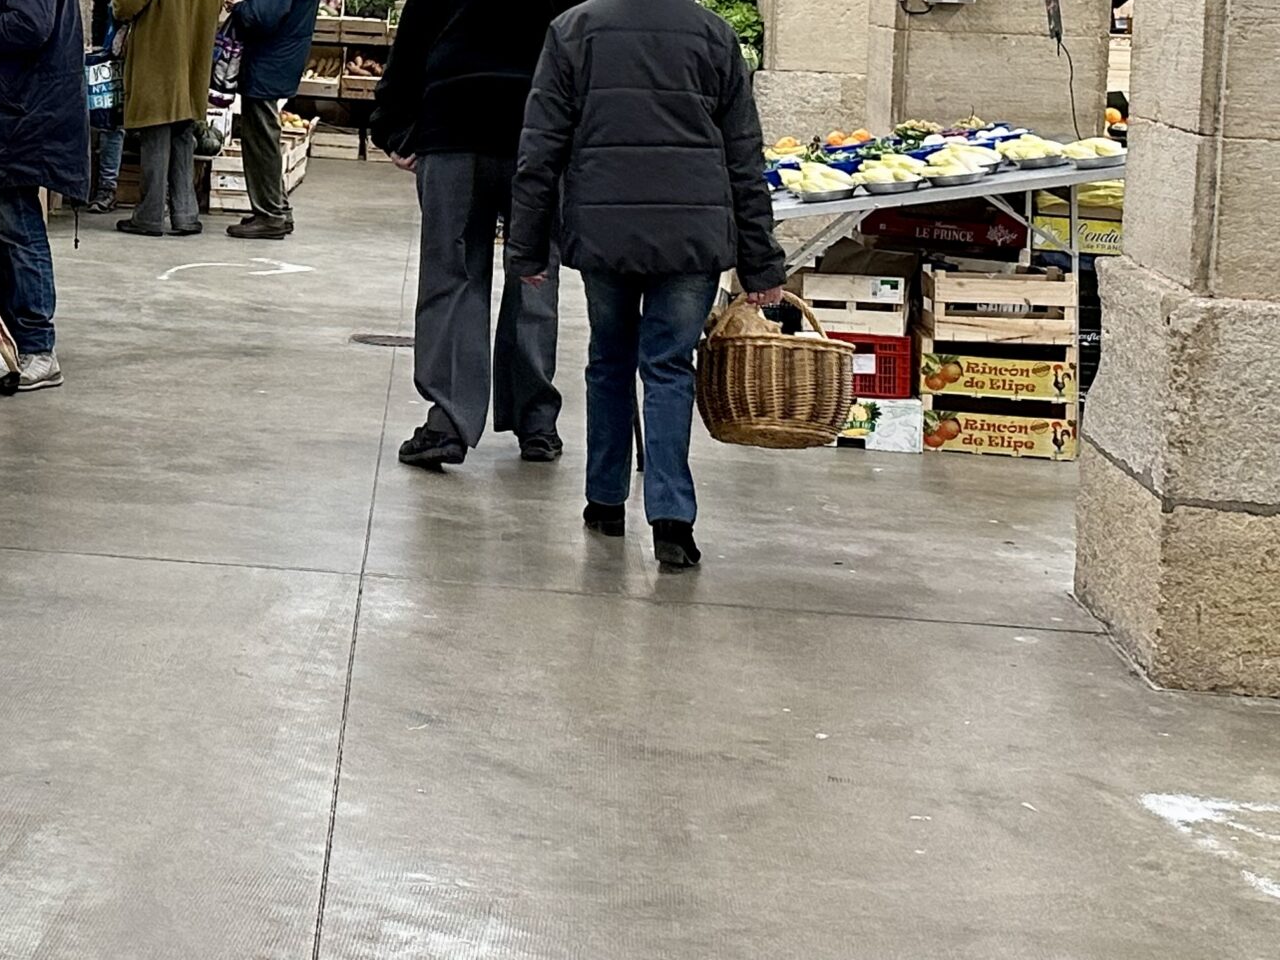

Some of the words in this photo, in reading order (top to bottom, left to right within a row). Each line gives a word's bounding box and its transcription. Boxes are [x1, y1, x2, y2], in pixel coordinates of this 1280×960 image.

[915, 227, 930, 239] LE
[933, 228, 974, 242] PRINCE
[964, 361, 1030, 378] Rincón
[963, 377, 986, 390] de
[988, 377, 1037, 395] Elipe
[963, 418, 1029, 435] Rincón
[961, 433, 984, 446] de
[987, 435, 1035, 452] Elipe
